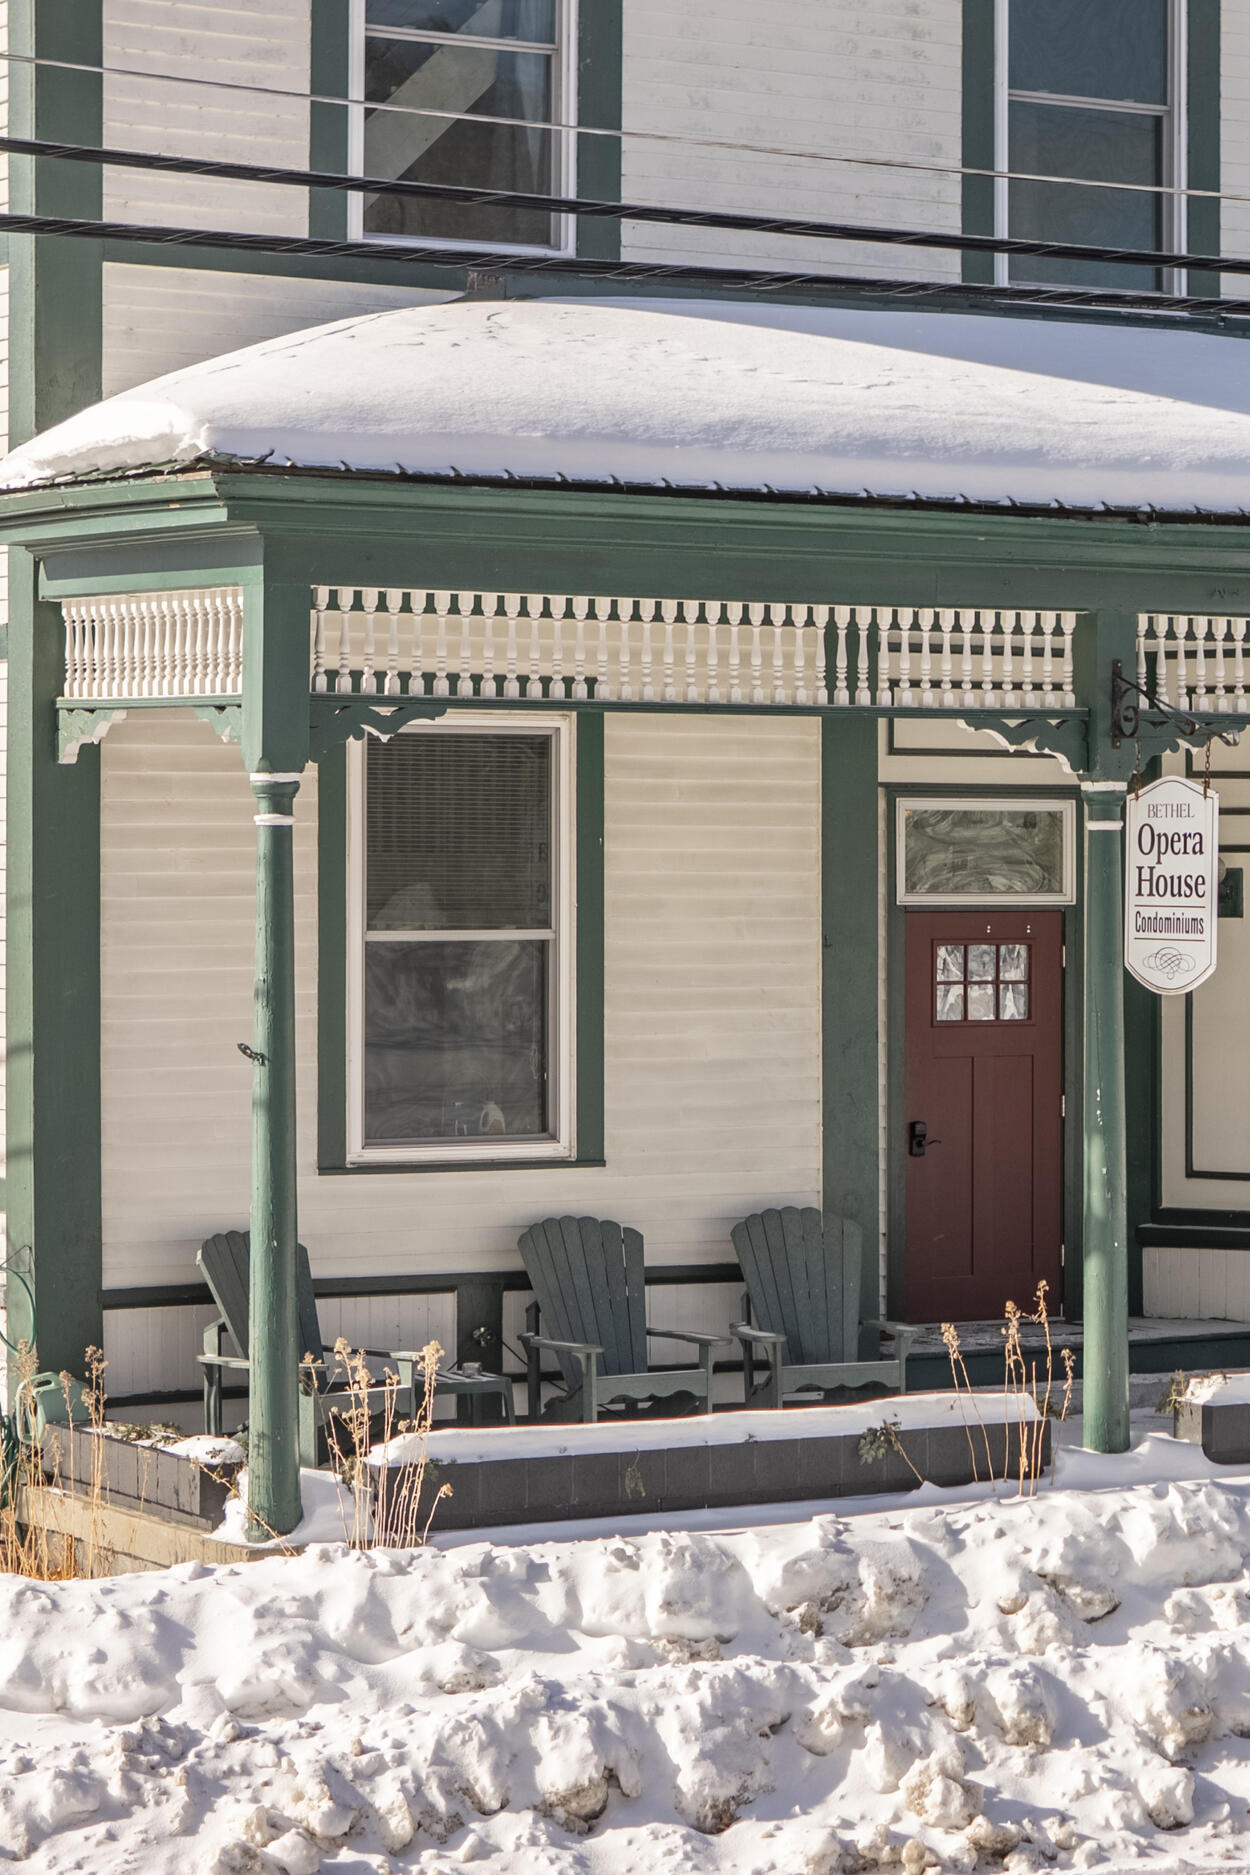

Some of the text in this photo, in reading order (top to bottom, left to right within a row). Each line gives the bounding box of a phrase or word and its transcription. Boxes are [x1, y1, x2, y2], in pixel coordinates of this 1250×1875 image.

[1147, 803, 1195, 819] BETHEL
[1137, 823, 1204, 864] Opera
[1135, 866, 1206, 898] House
[1135, 910, 1204, 935] Condominiums
